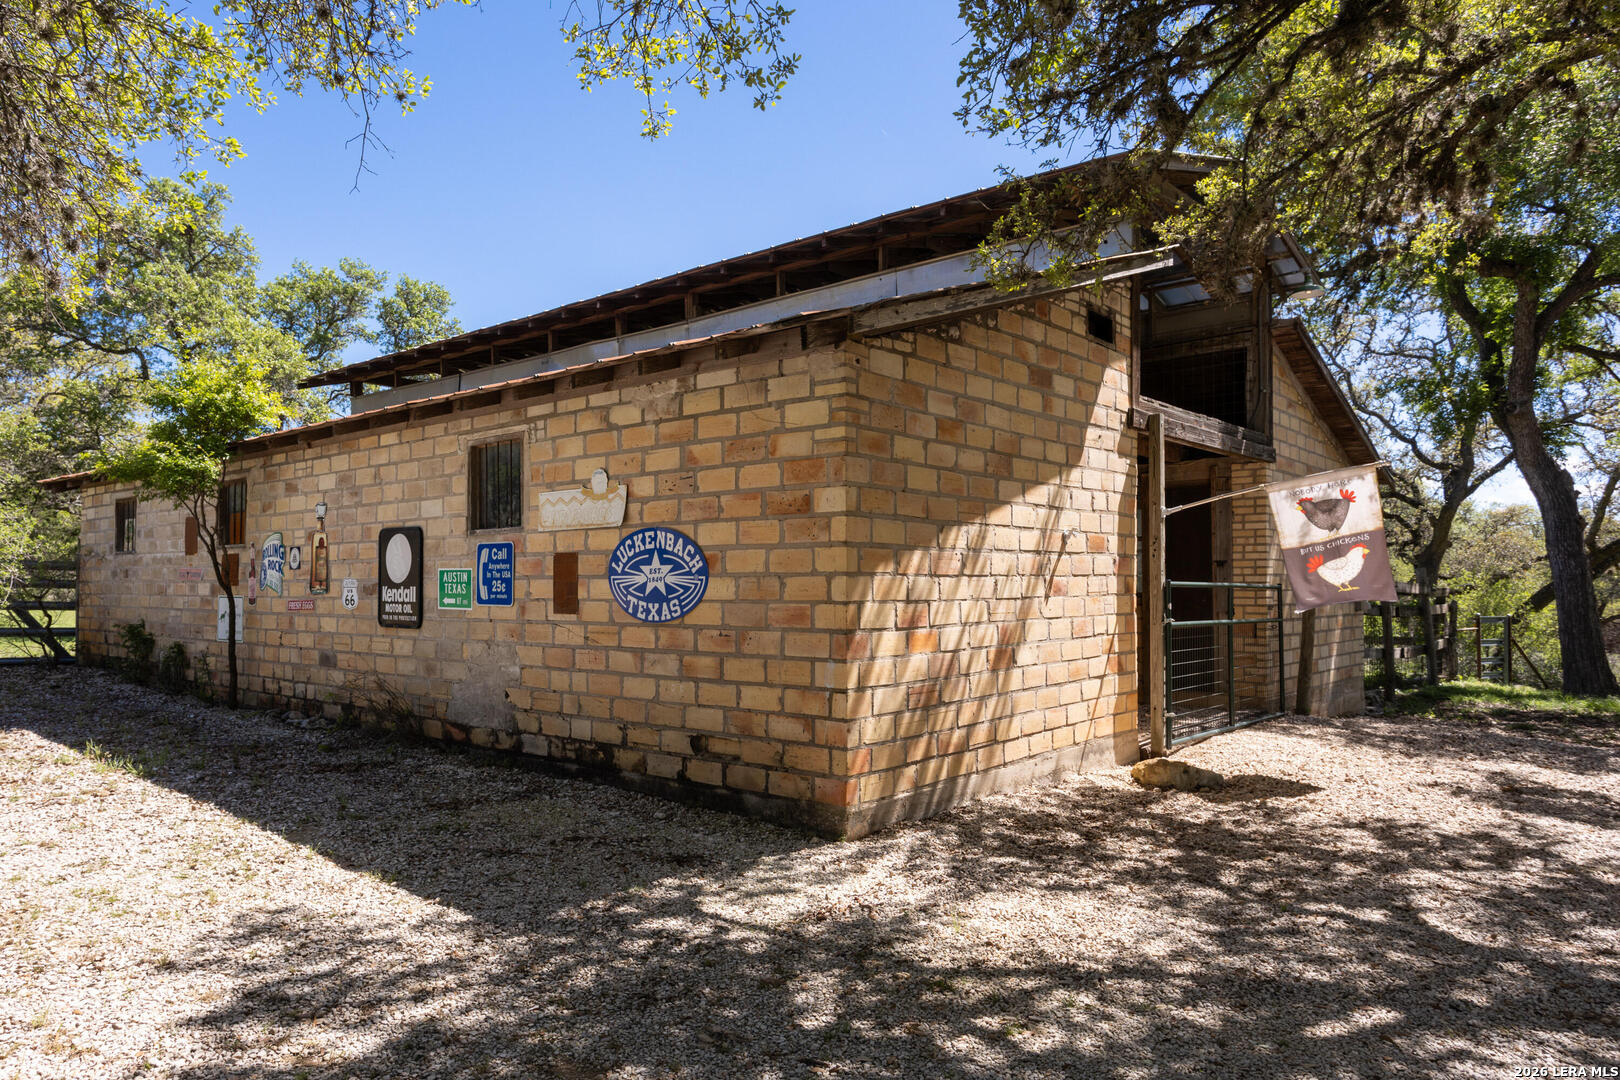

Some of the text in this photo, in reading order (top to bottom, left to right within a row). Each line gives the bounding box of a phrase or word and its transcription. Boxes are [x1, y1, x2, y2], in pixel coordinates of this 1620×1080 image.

[1289, 485, 1322, 497] NOBODY
[262, 544, 284, 561] ROLLING
[491, 548, 507, 560] Call
[611, 530, 704, 574] LUCKENBACH
[1300, 546, 1313, 555] BUT
[1314, 544, 1325, 552] US
[267, 559, 284, 575] ROCK
[488, 563, 510, 571] Anywhere
[443, 571, 468, 583] AUSTIN
[501, 570, 511, 578] USA
[382, 585, 417, 602] Kendall
[444, 583, 467, 594] TEXAS
[302, 600, 314, 610] EGGS
[344, 594, 356, 606] 66
[385, 603, 413, 613] MOTOR OIL
[626, 595, 682, 621] TEXAS
